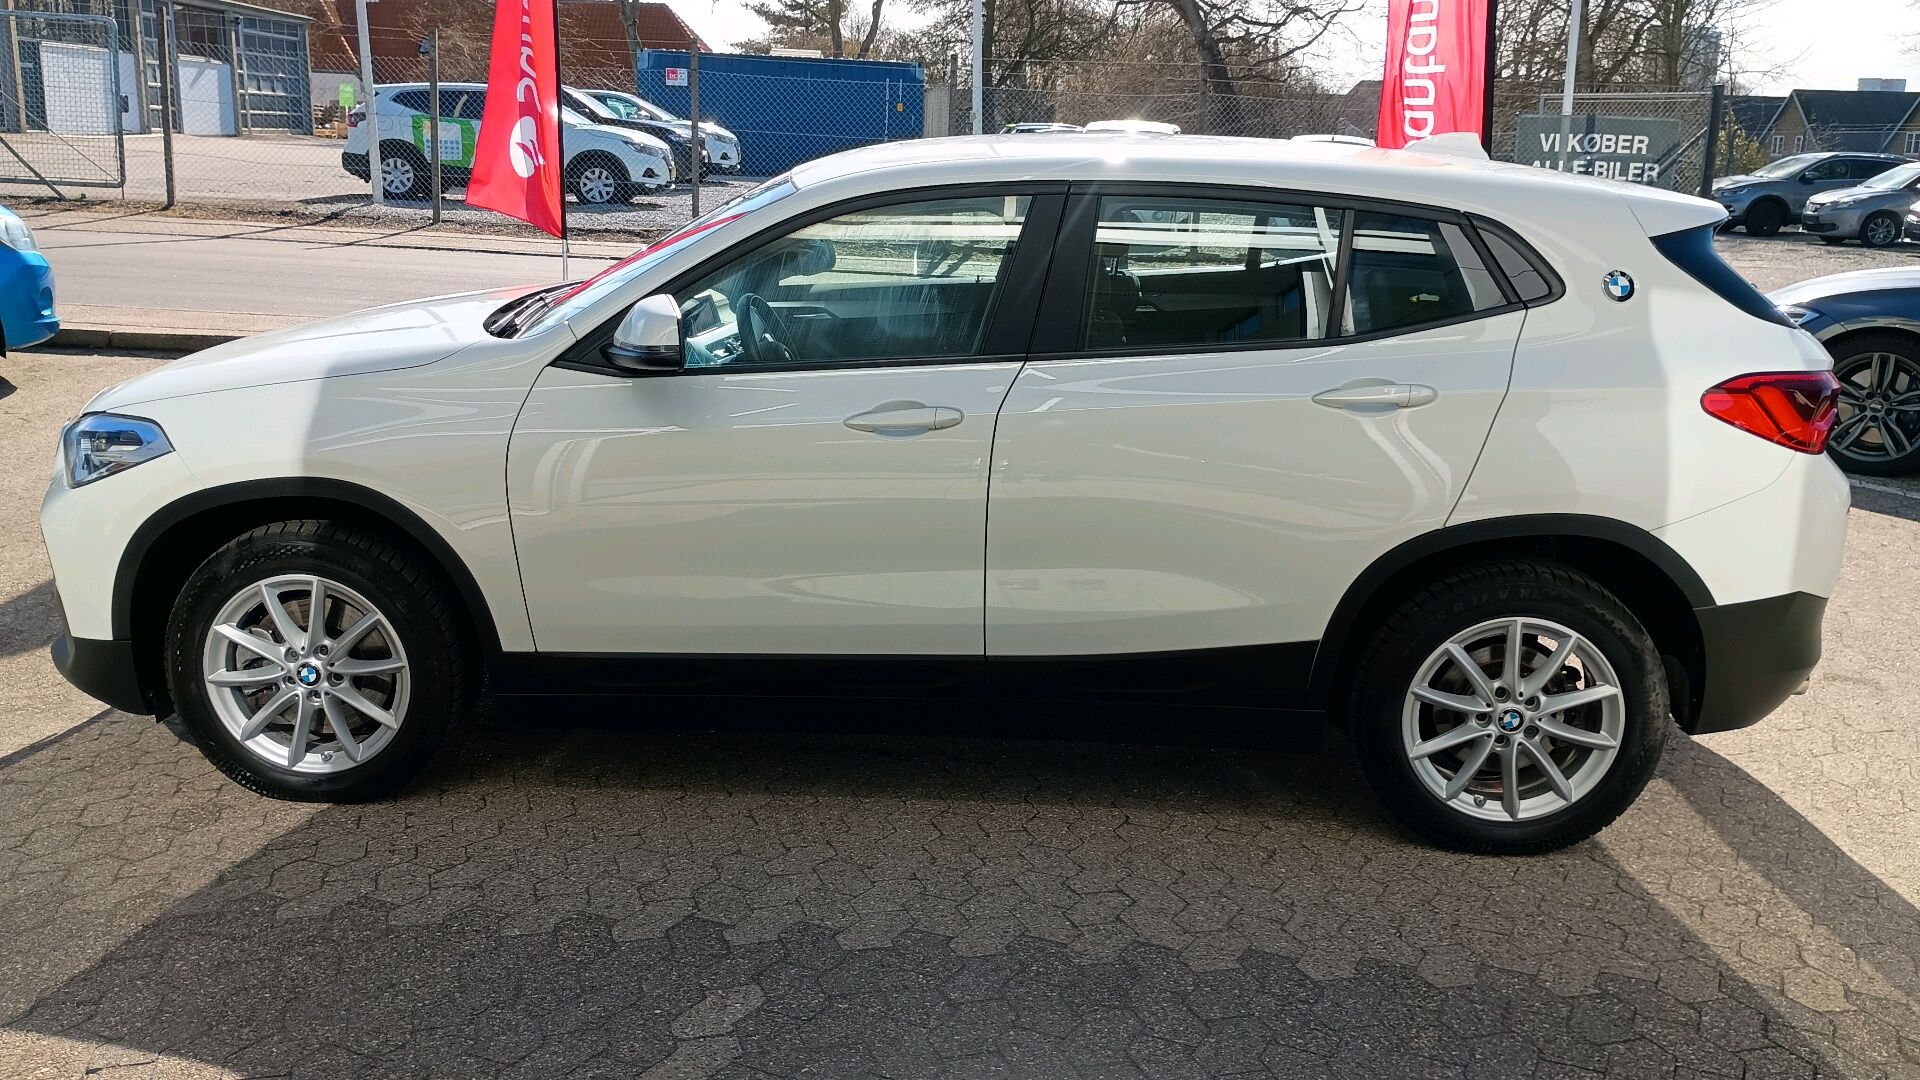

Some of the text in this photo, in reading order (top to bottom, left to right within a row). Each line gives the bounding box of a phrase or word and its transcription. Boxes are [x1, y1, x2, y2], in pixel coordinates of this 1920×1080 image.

[1540, 133, 1649, 154] VI KØBER
[1594, 161, 1660, 181] BILER
